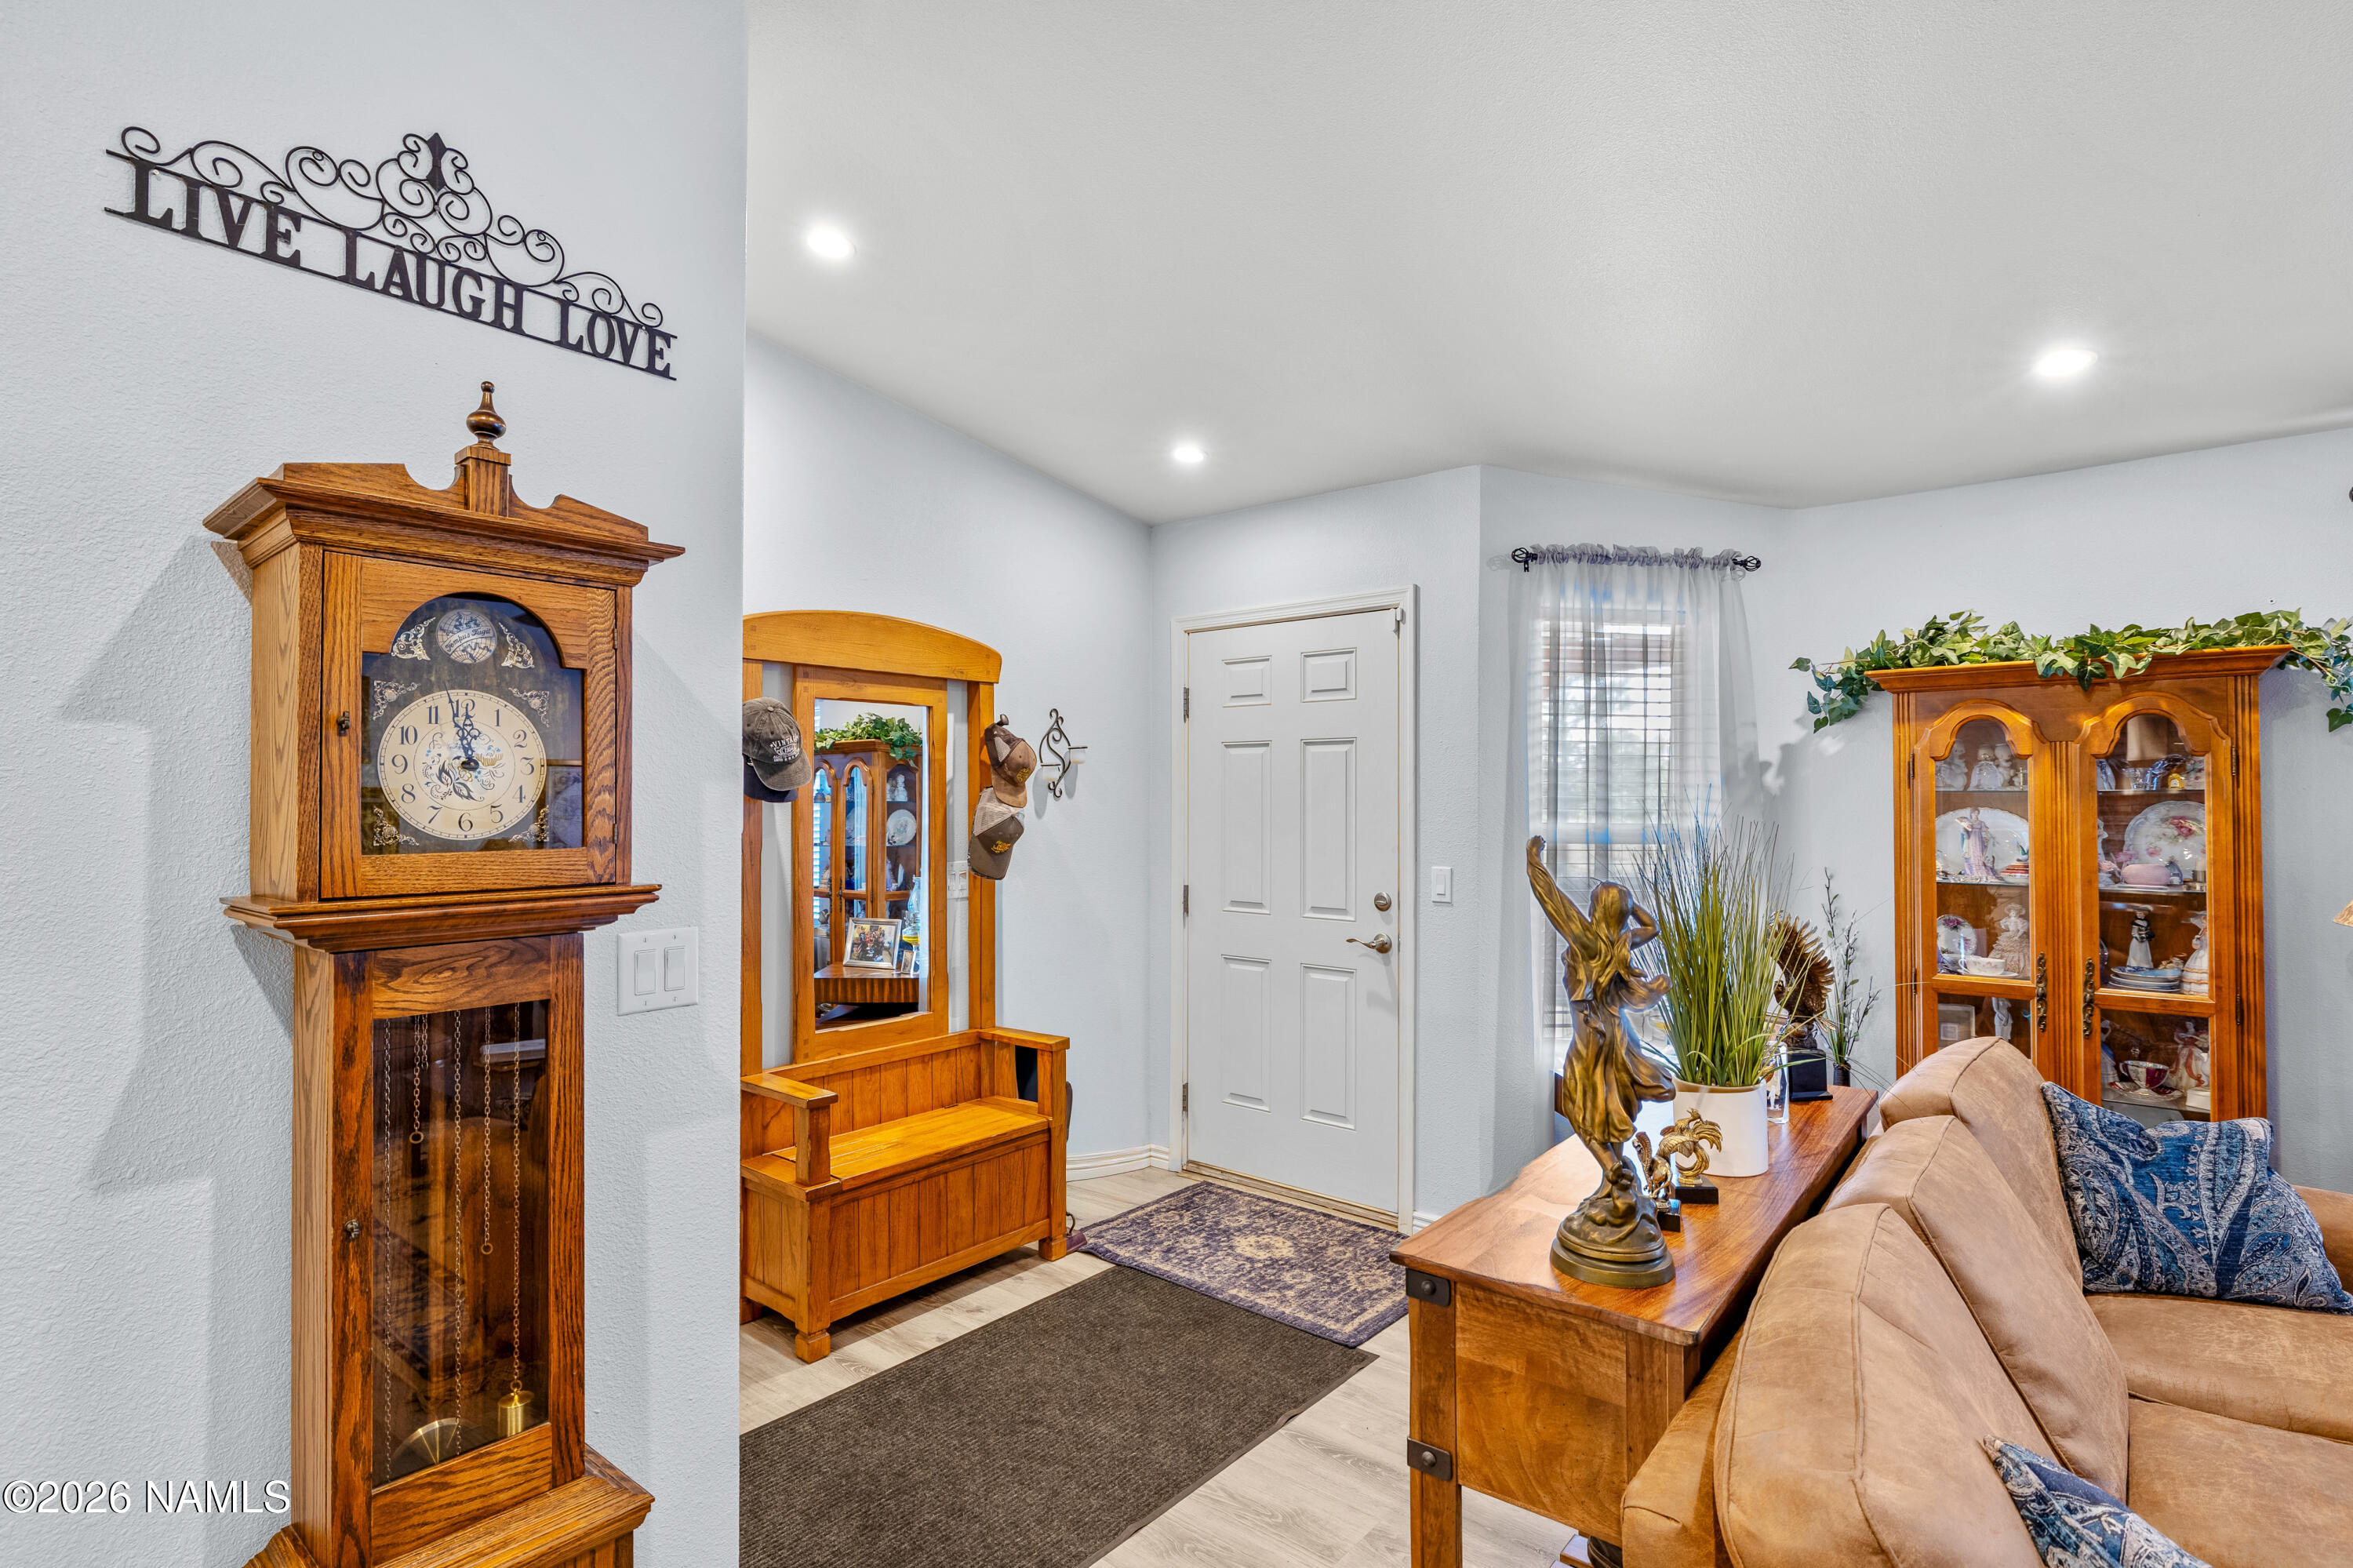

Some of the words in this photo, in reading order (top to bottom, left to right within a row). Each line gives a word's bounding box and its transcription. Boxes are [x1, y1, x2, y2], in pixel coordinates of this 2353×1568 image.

[125, 160, 301, 267] LIVE
[337, 228, 526, 334] LAUGH
[551, 297, 673, 377] LOVE
[445, 634, 471, 652] Tempus
[427, 705, 438, 724] 11
[495, 709, 500, 726] 1
[399, 726, 417, 745] 10
[514, 729, 527, 748] 2
[391, 755, 408, 773] 9
[520, 757, 534, 775] 3
[402, 784, 416, 803] 8
[512, 785, 526, 802] 4
[427, 806, 442, 824] 7
[458, 813, 473, 831] 6
[490, 804, 504, 823] 5
